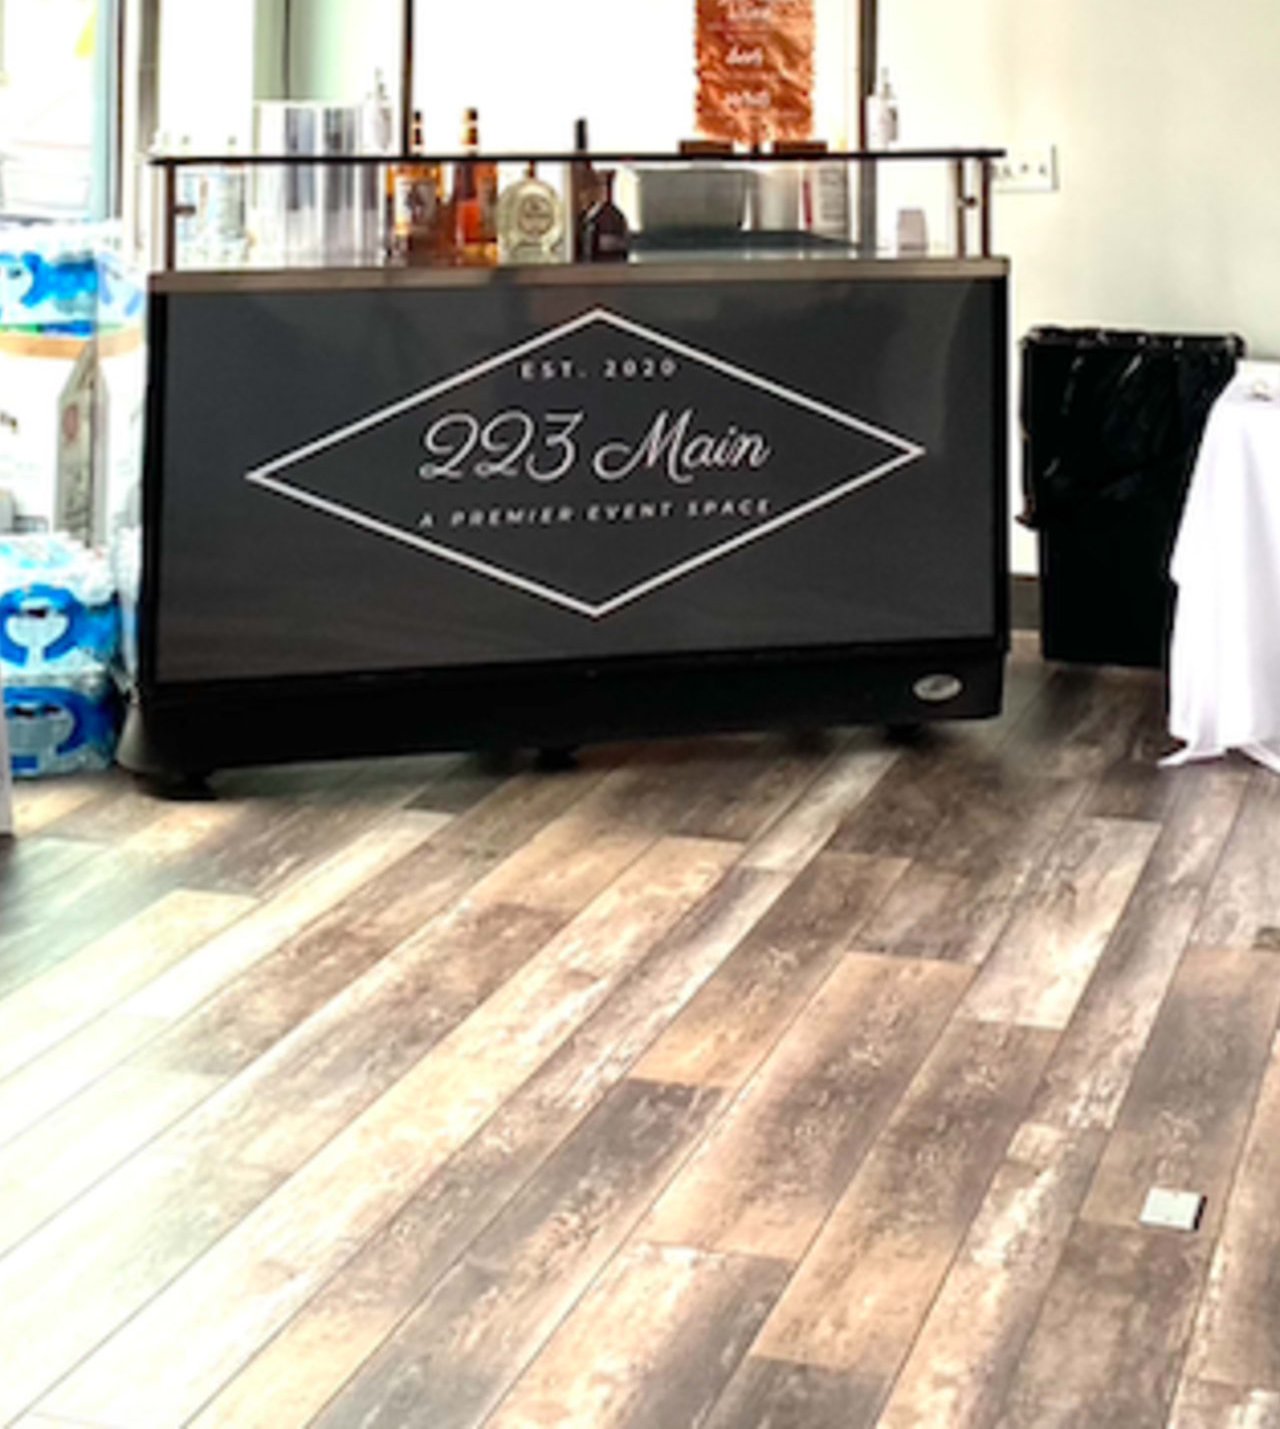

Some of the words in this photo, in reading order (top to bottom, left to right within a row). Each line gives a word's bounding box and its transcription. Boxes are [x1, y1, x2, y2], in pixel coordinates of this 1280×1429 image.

[521, 359, 587, 379] EST.
[604, 357, 677, 378] 2020
[419, 410, 584, 482] 223
[593, 408, 771, 484] Main
[419, 512, 434, 529] A
[451, 504, 573, 526] PREMIER
[586, 501, 672, 521] EVENT
[687, 497, 769, 517] SPACE
